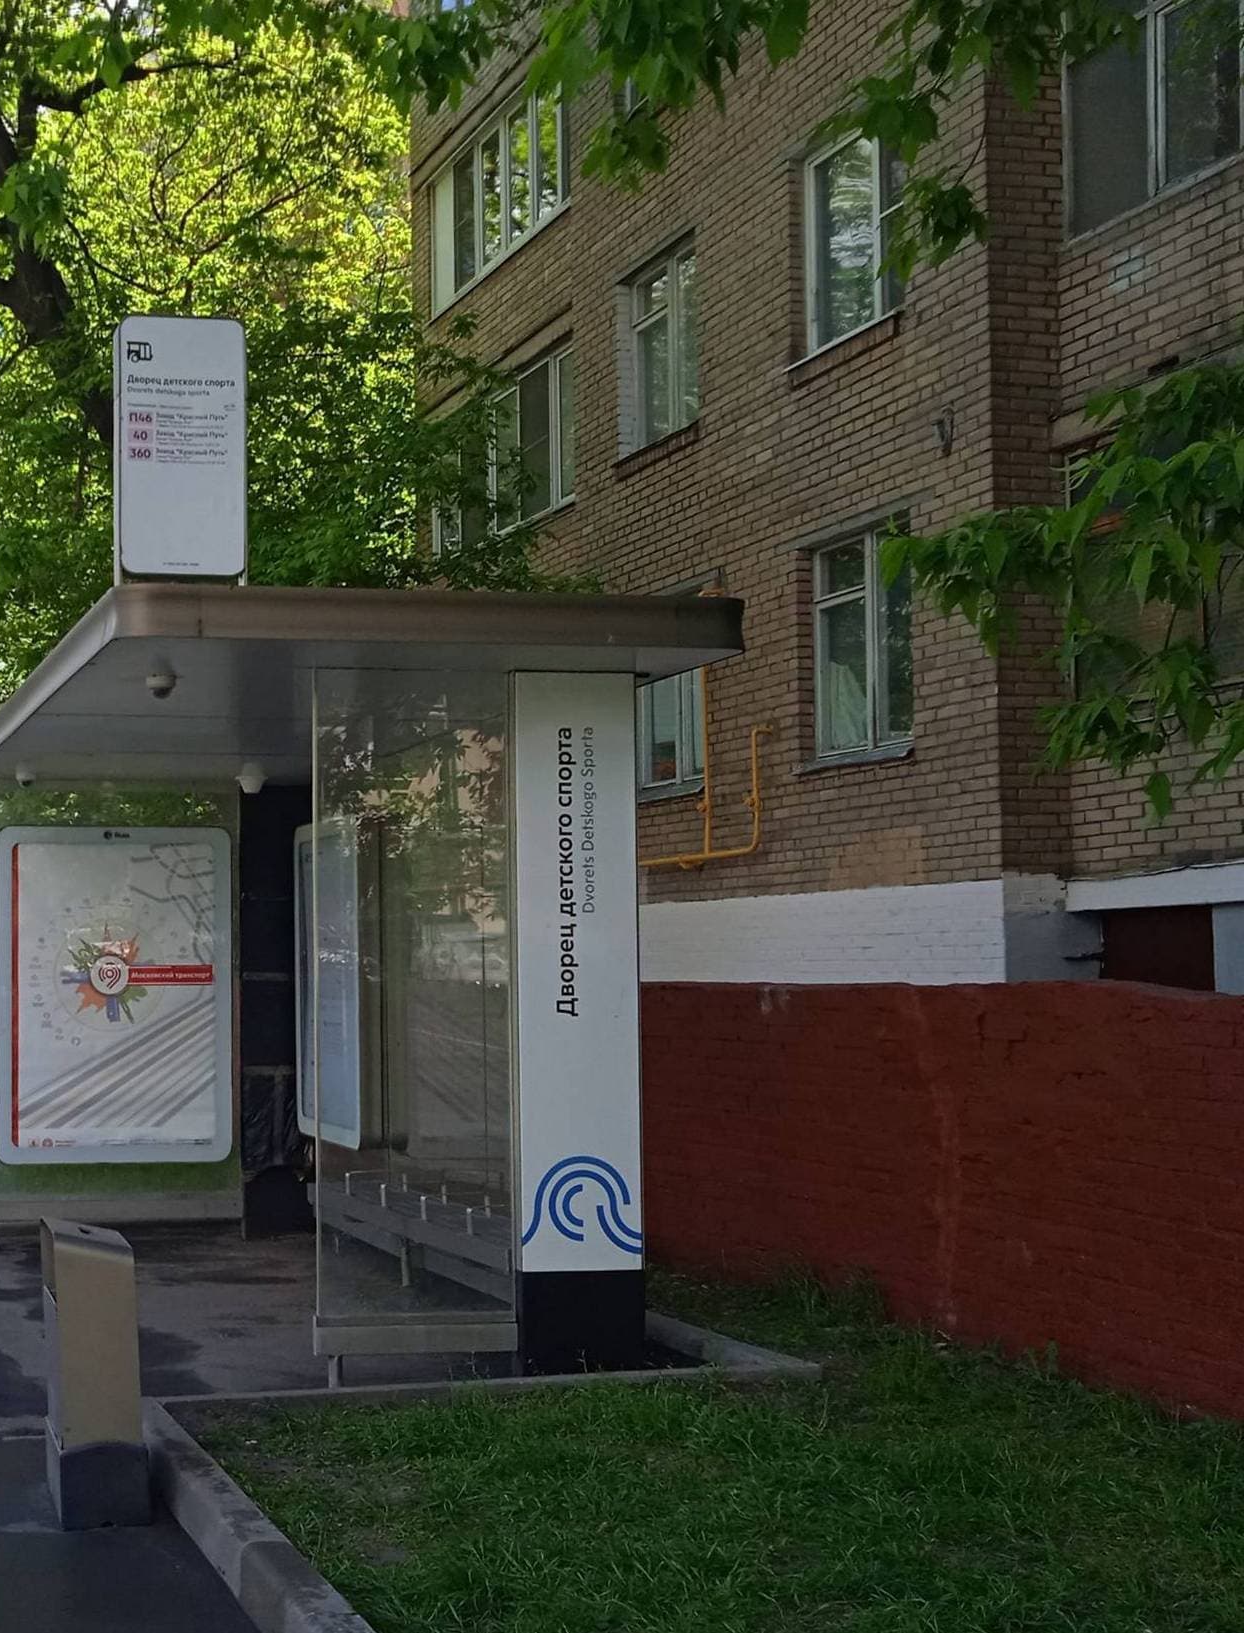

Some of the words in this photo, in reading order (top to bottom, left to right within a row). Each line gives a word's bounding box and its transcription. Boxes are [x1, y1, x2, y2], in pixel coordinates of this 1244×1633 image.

[127, 374, 162, 385] Дворец
[163, 378, 203, 386] детского
[204, 379, 236, 388] спорта
[130, 448, 152, 459] 360
[133, 430, 148, 441] 40
[556, 727, 577, 808] спорта
[581, 726, 597, 777] Sporta
[580, 781, 597, 851] Detskogo
[556, 813, 577, 918] детского
[581, 855, 596, 914] Dvorets
[131, 970, 174, 979] Московский
[175, 971, 211, 980] транспорт
[556, 922, 579, 1017] Дворец
